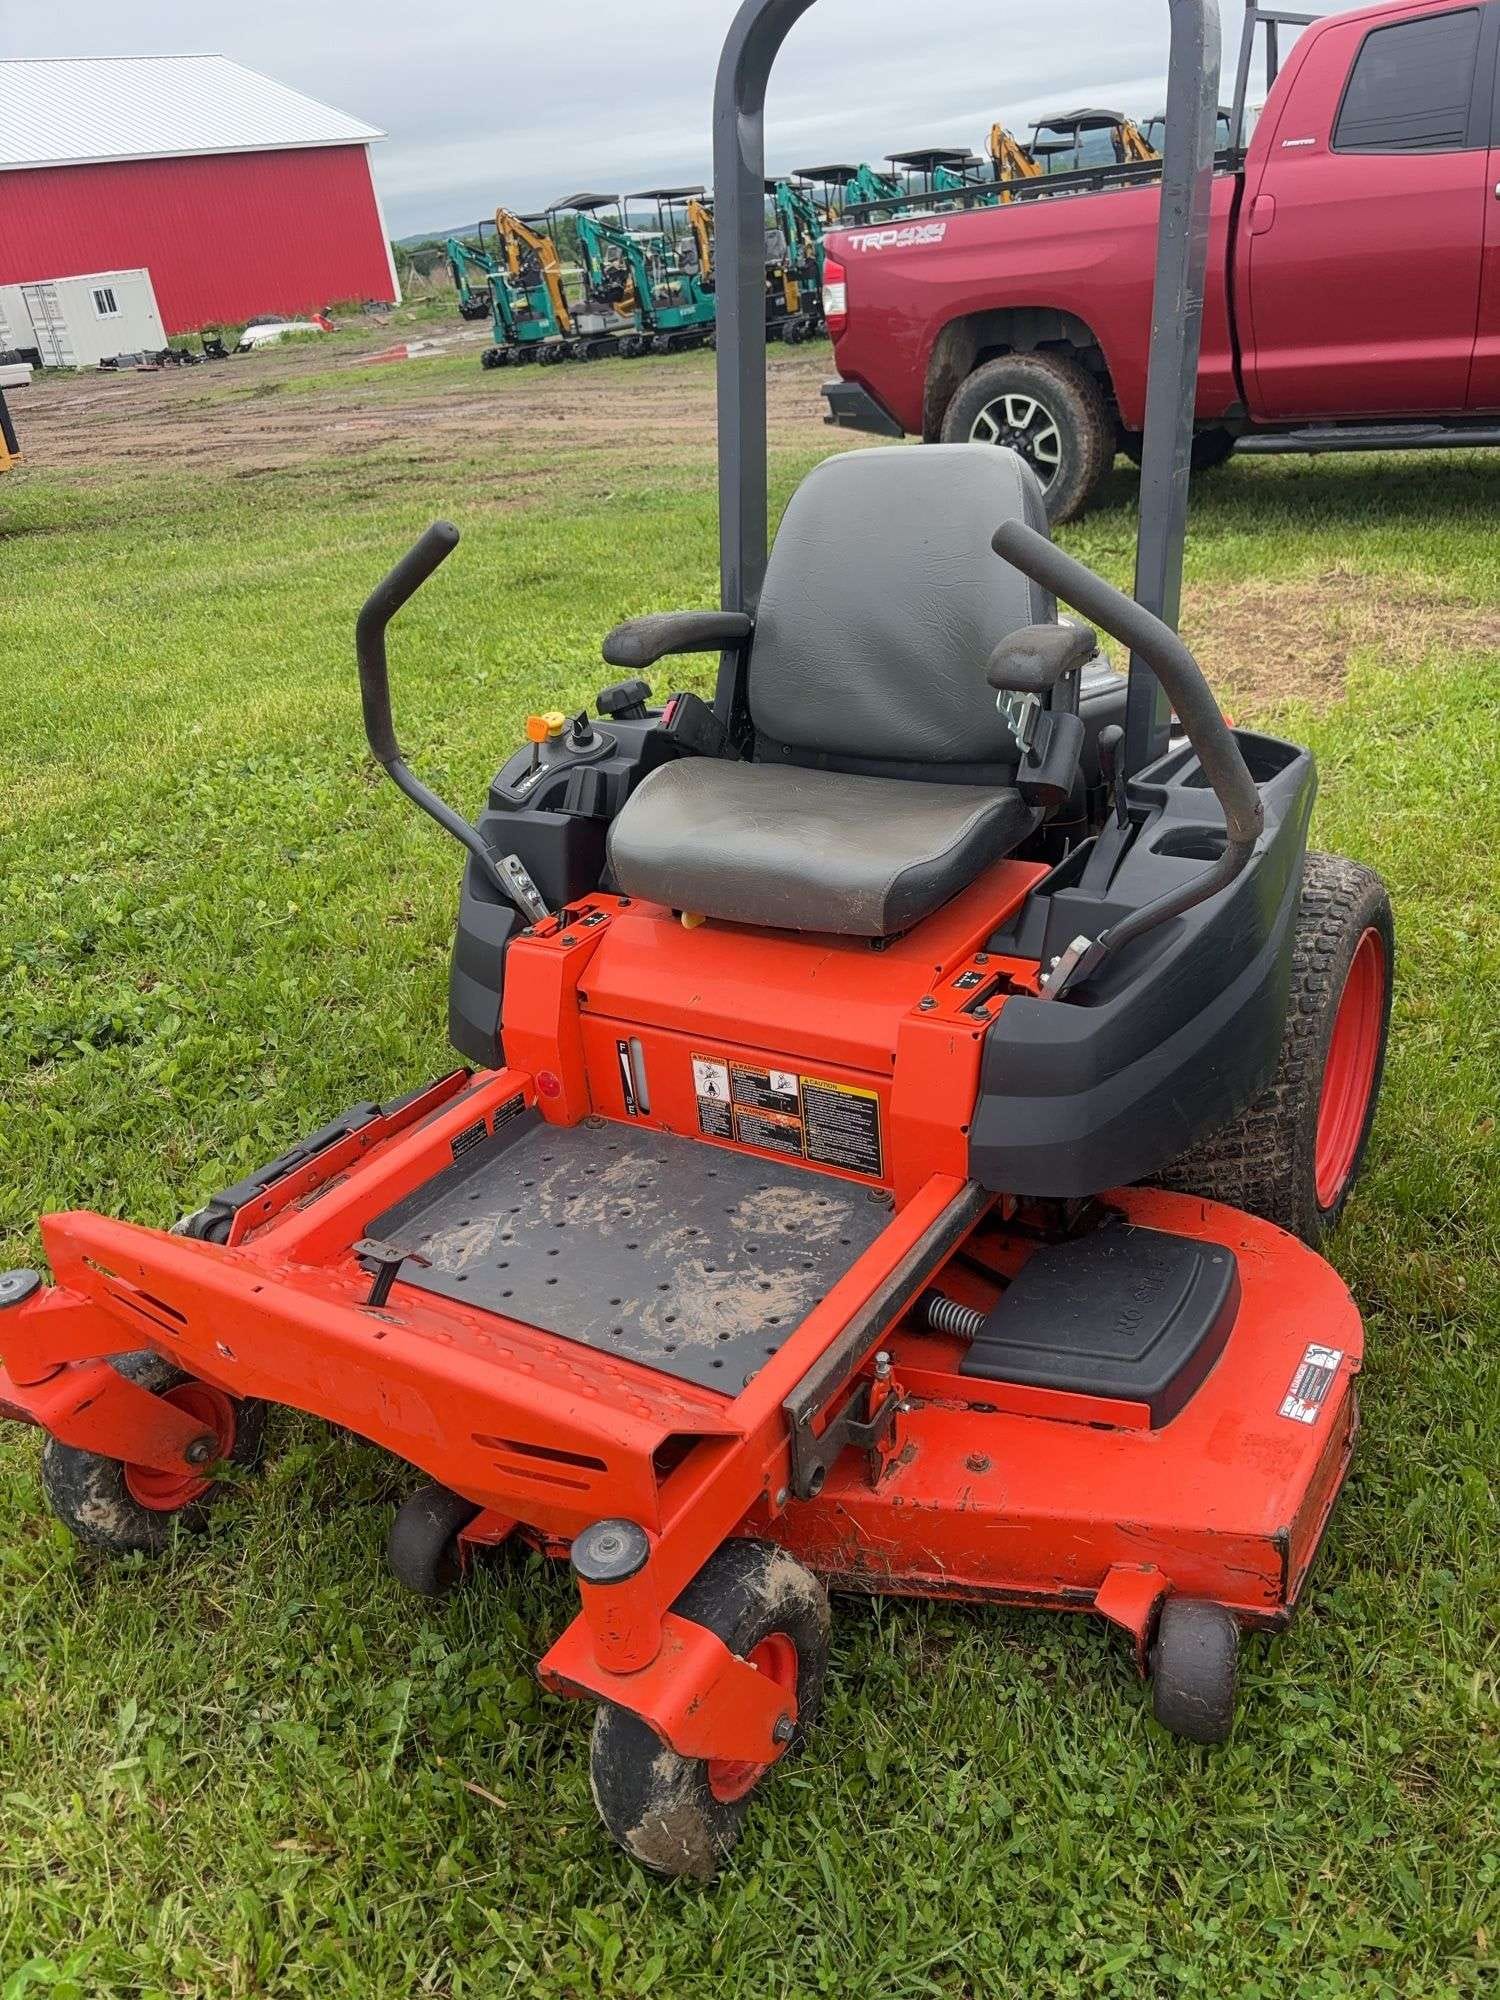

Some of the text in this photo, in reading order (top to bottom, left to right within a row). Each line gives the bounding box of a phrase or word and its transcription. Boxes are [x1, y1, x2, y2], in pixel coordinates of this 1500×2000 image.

[848, 230, 897, 252] TRD
[620, 1043, 626, 1051] F
[699, 1055, 725, 1065] WARNING
[739, 1064, 766, 1075] WARNING
[809, 1079, 838, 1090] CAUTION
[629, 1105, 636, 1114] E
